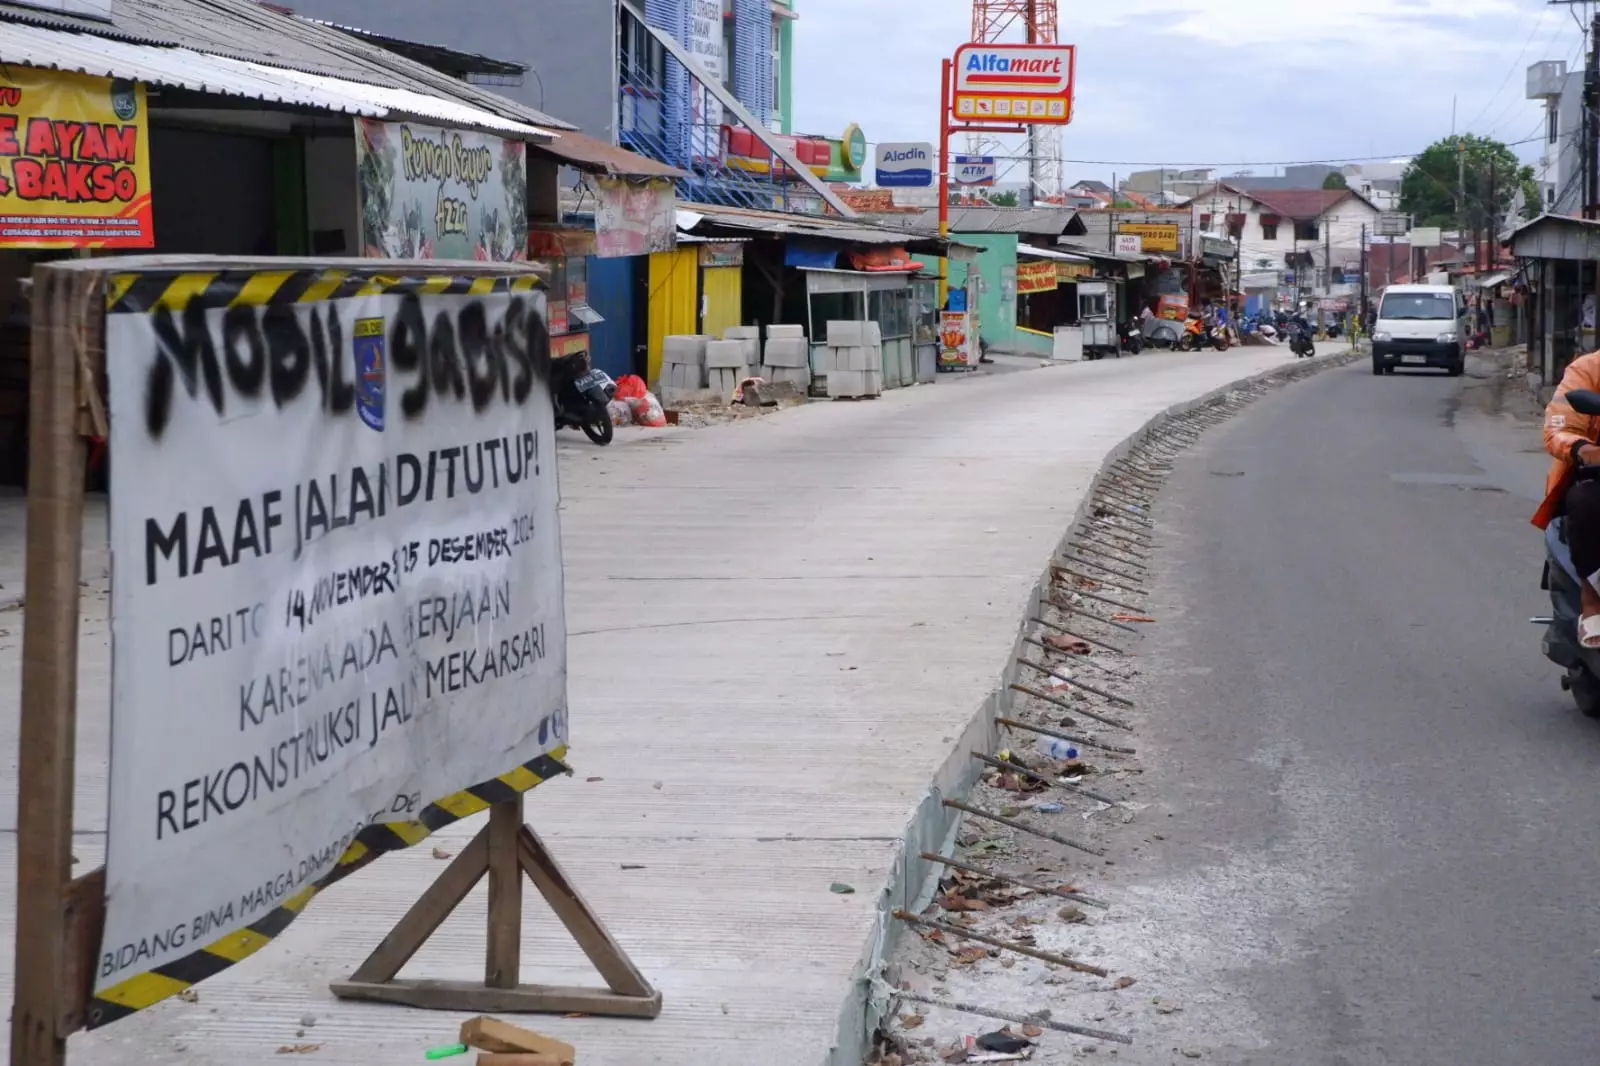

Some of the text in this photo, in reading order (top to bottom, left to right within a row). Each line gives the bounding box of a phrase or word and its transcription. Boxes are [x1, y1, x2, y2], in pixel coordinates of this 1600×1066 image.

[966, 54, 1062, 73] Alfamart
[26, 117, 137, 164] AYAM
[400, 124, 492, 200] Rumah Sayur
[883, 148, 925, 162] Aladin
[961, 166, 986, 175] ATM
[12, 158, 137, 203] BAKSO
[147, 292, 355, 443] MOBIL
[145, 489, 282, 586] MAAF
[396, 429, 540, 507] DITUTUP!
[169, 613, 232, 667] DARI
[428, 527, 511, 567] DESEMBER
[340, 620, 399, 680] ADA
[156, 697, 361, 841] REKONSTRUKSI
[426, 623, 545, 699] MEKARSARI
[101, 923, 186, 978] BIDANG
[191, 904, 235, 941] BINA
[240, 869, 294, 918] MARGA
